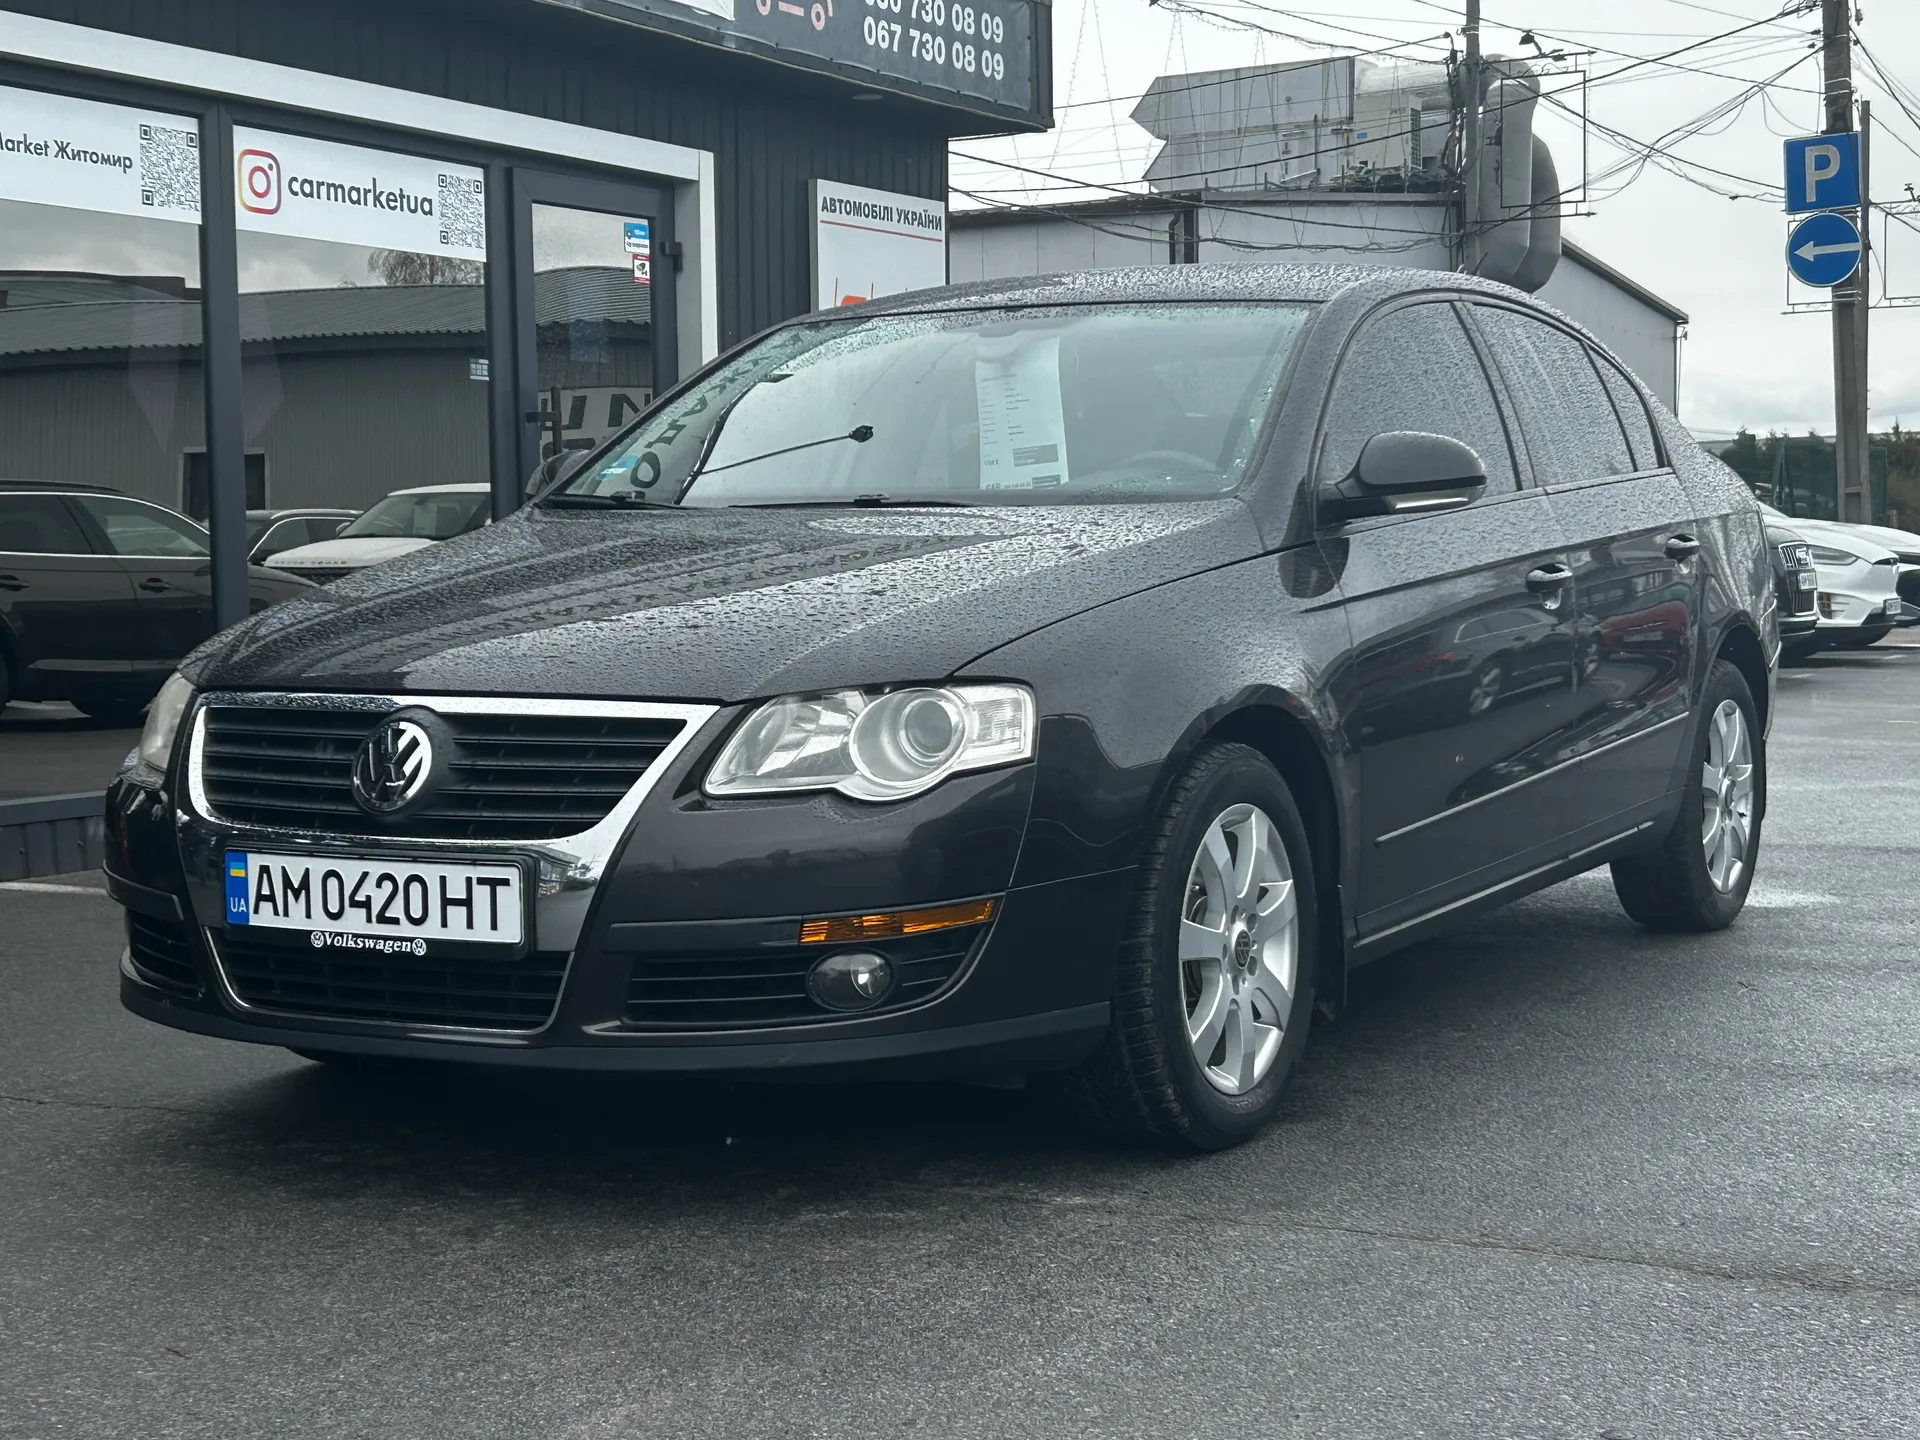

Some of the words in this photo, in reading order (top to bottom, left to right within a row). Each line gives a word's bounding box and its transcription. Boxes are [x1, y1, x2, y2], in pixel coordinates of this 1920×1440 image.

[911, 0, 946, 26] 730
[952, 3, 976, 35] 08
[981, 12, 1004, 43] 09
[863, 16, 902, 52] 067
[909, 28, 946, 65] 730
[952, 41, 976, 73] 08
[981, 50, 1005, 81] 09
[0, 131, 50, 156] arket
[53, 139, 133, 174] Житомир
[1804, 144, 1841, 203] P
[287, 176, 433, 216] carmarketua
[821, 196, 894, 222] АВТОМОБІЛІ
[896, 207, 942, 231] УКРАЇНИ
[230, 897, 247, 913] UA
[324, 931, 412, 954] Volkswagen
